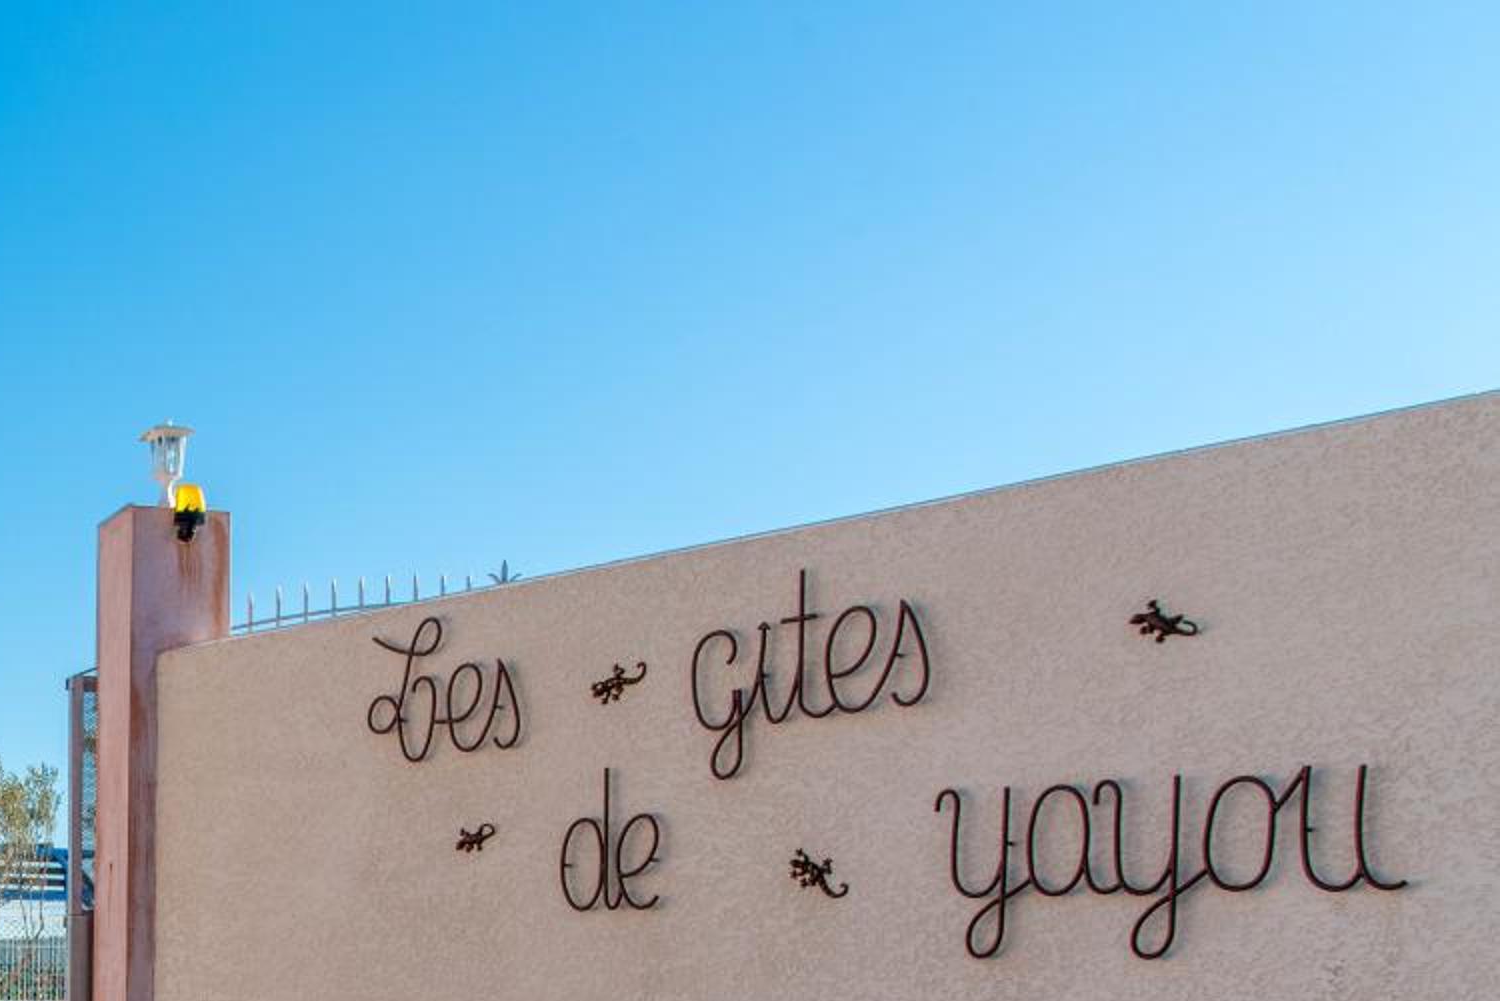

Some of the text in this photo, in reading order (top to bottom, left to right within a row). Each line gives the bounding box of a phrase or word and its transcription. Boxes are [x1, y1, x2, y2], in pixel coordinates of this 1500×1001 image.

[367, 616, 521, 763] Les
[560, 763, 1409, 961] de yayou
